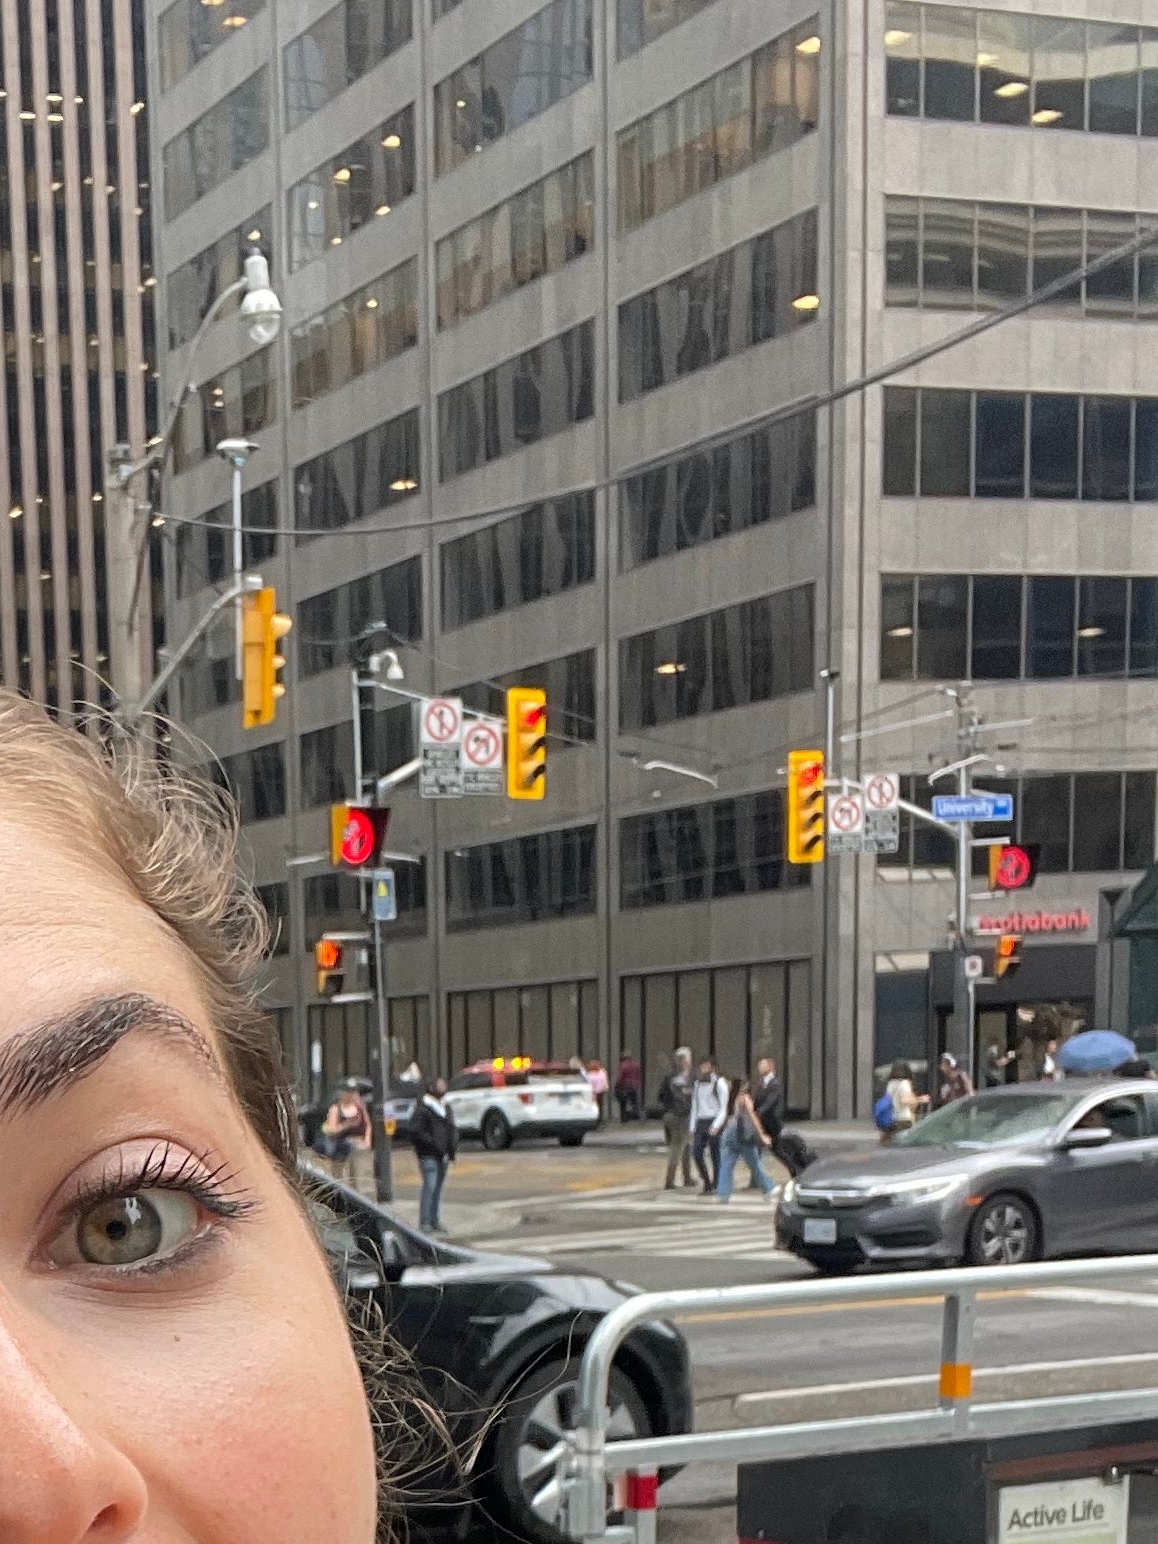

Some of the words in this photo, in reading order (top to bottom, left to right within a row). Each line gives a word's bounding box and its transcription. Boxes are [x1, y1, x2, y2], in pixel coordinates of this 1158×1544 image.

[937, 798, 993, 818] University
[1008, 1504, 1067, 1530] Active
[1072, 1499, 1105, 1523] Life
